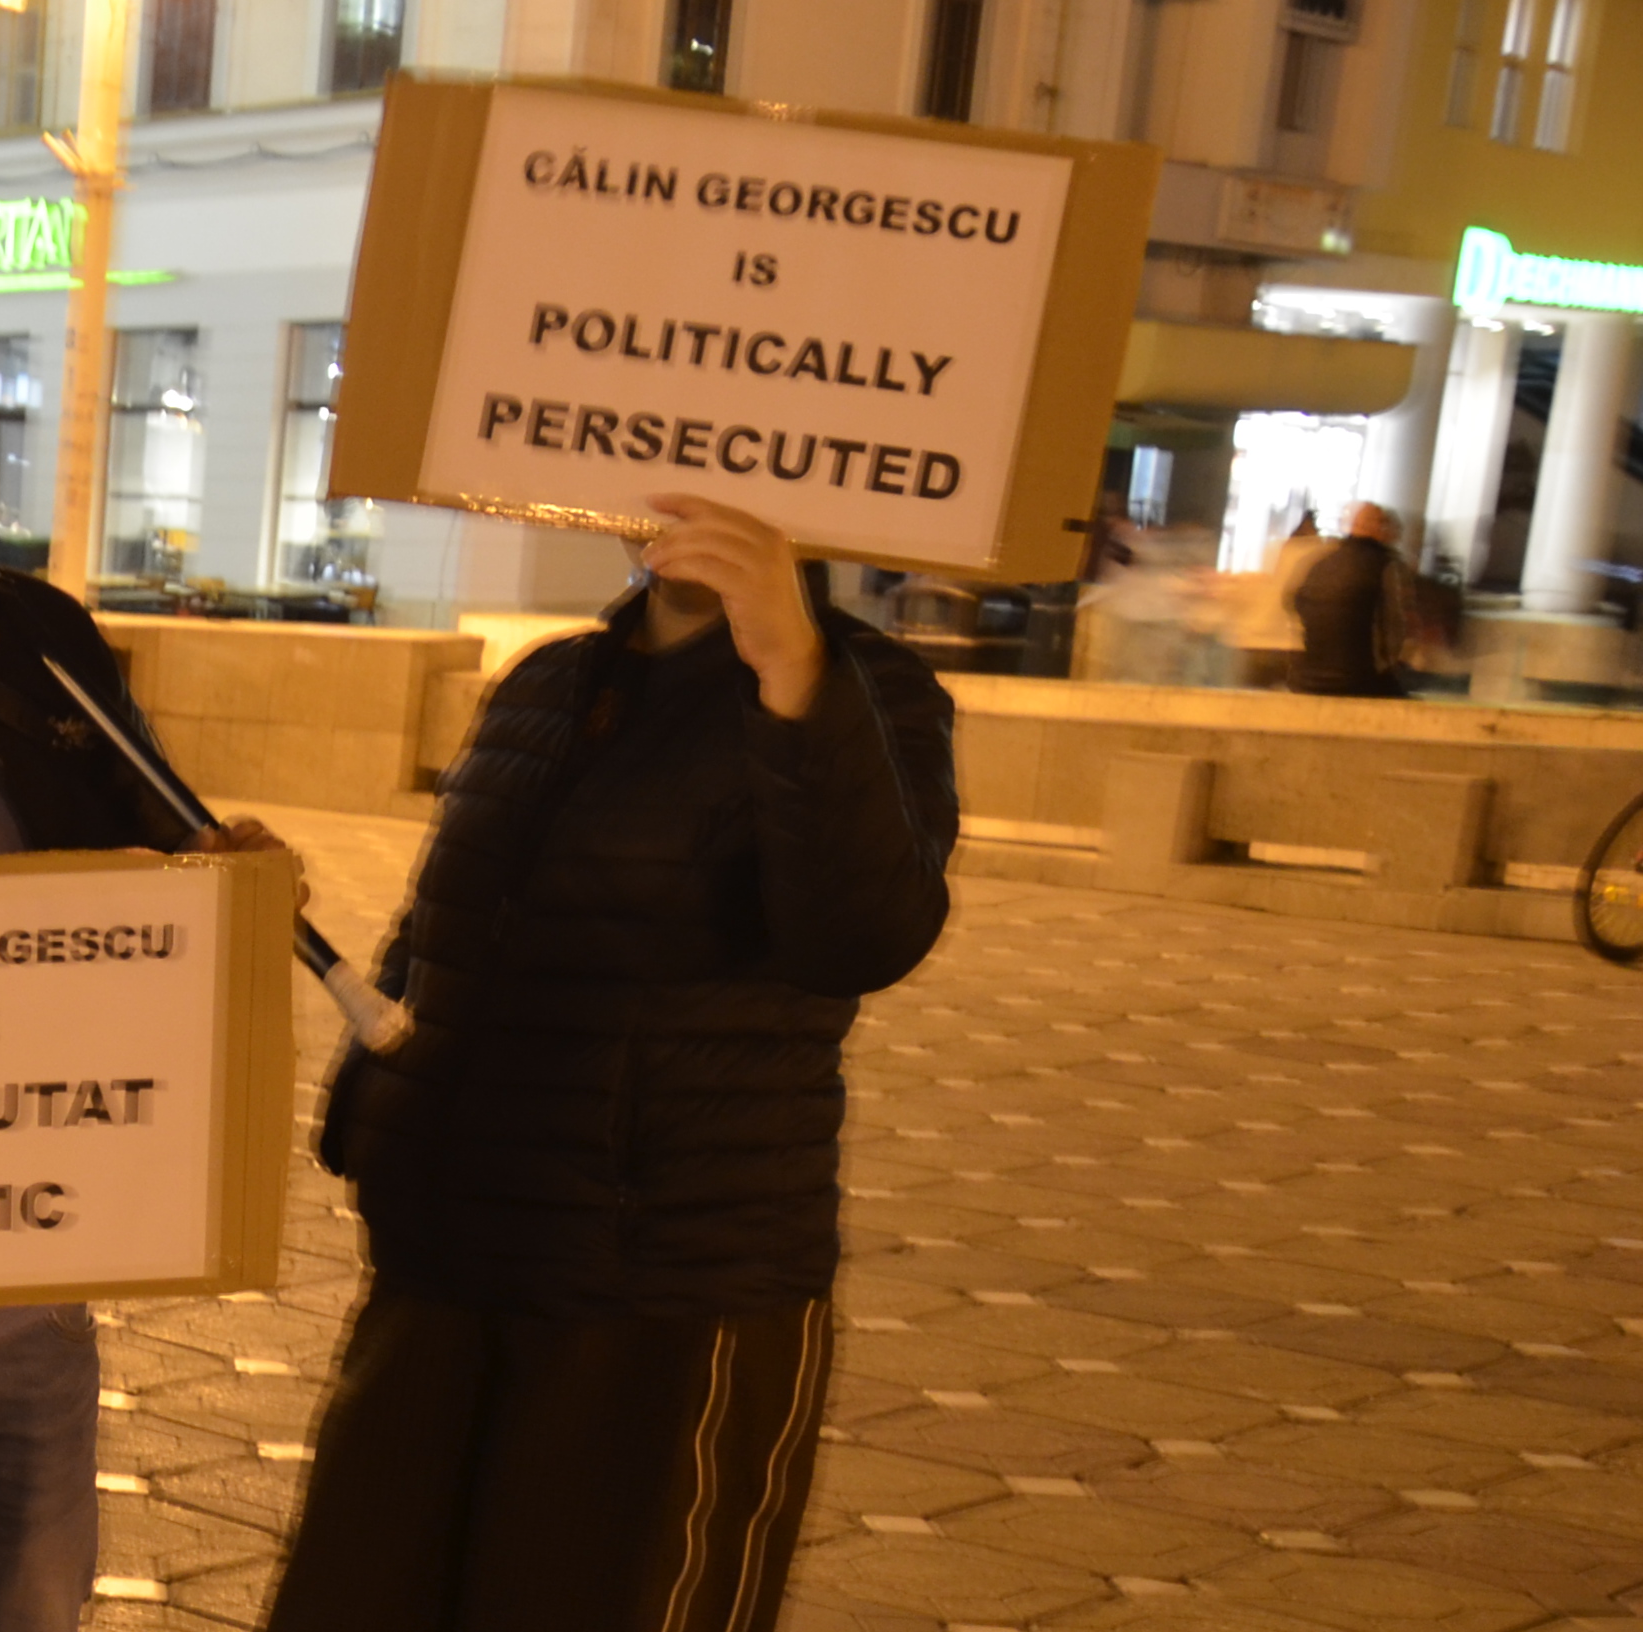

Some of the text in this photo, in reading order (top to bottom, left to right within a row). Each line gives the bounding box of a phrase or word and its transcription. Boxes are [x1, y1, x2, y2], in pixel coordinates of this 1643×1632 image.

[523, 145, 1020, 245] CĂLIN GEORGESCU
[732, 251, 778, 287] IS
[529, 302, 953, 397] POLITICALLY
[478, 392, 963, 500] PERSECUTED
